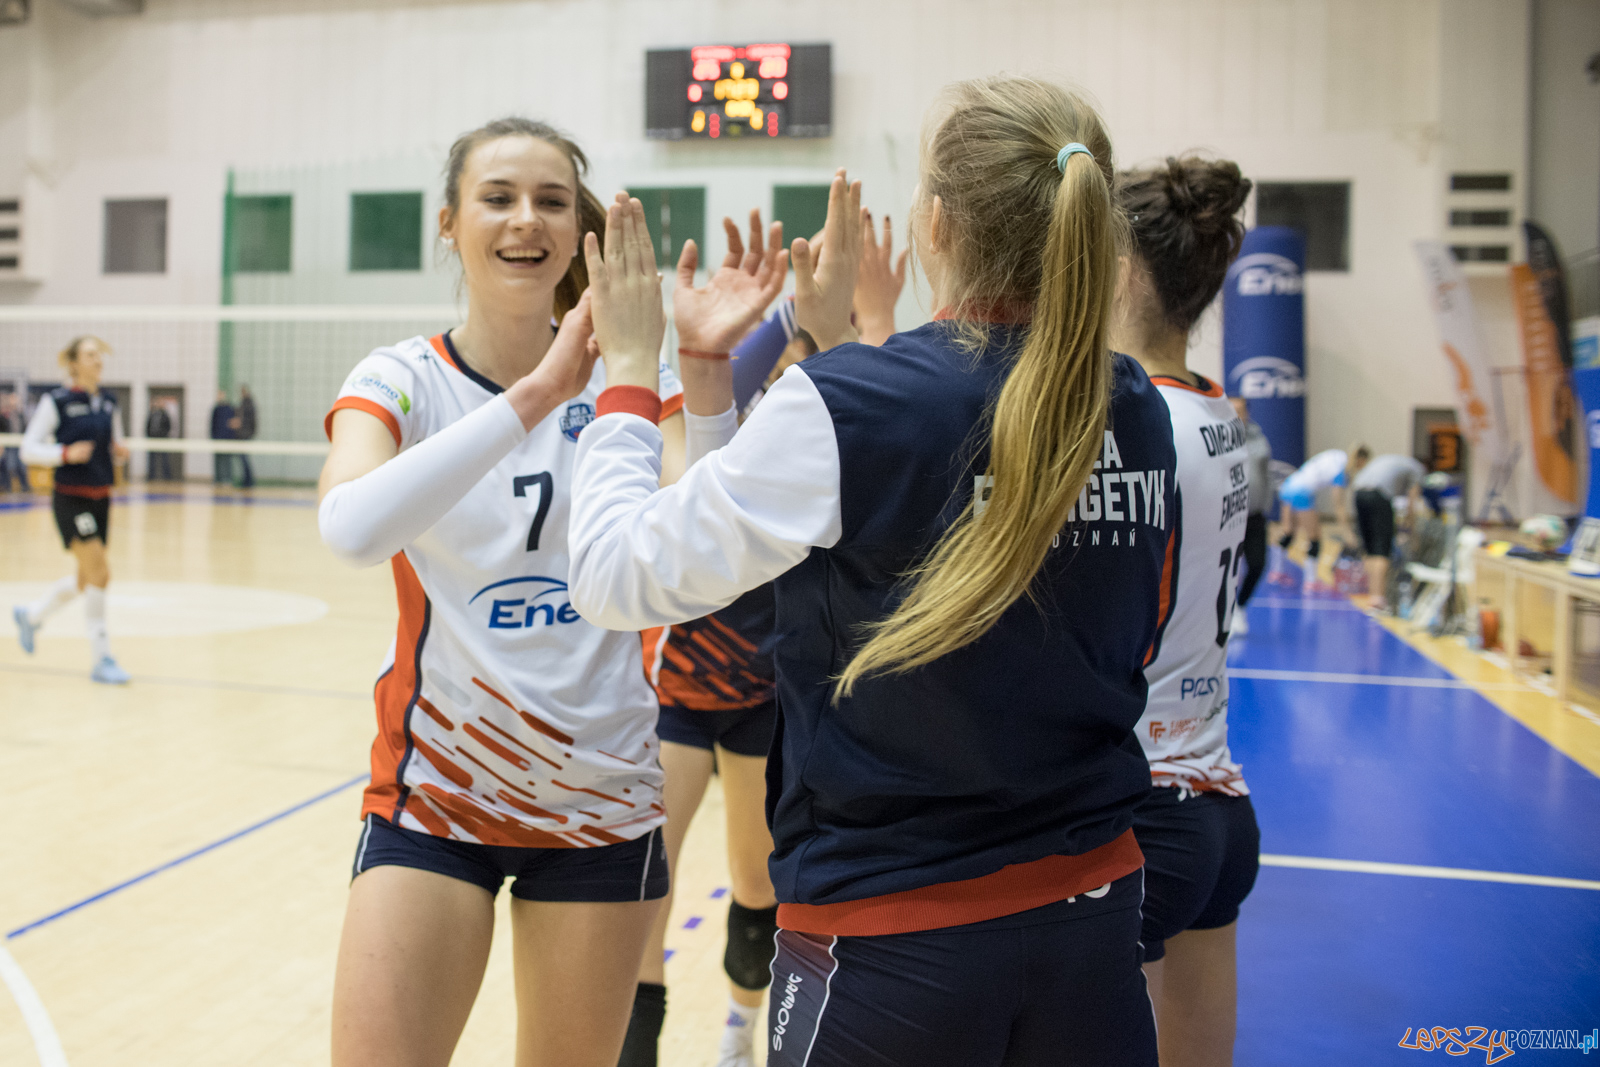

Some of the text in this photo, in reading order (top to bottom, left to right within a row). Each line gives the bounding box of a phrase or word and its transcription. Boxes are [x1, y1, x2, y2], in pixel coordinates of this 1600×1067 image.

[513, 471, 553, 552] 7
[1052, 528, 1136, 548] OZNAŃ
[488, 598, 581, 629] Ene
